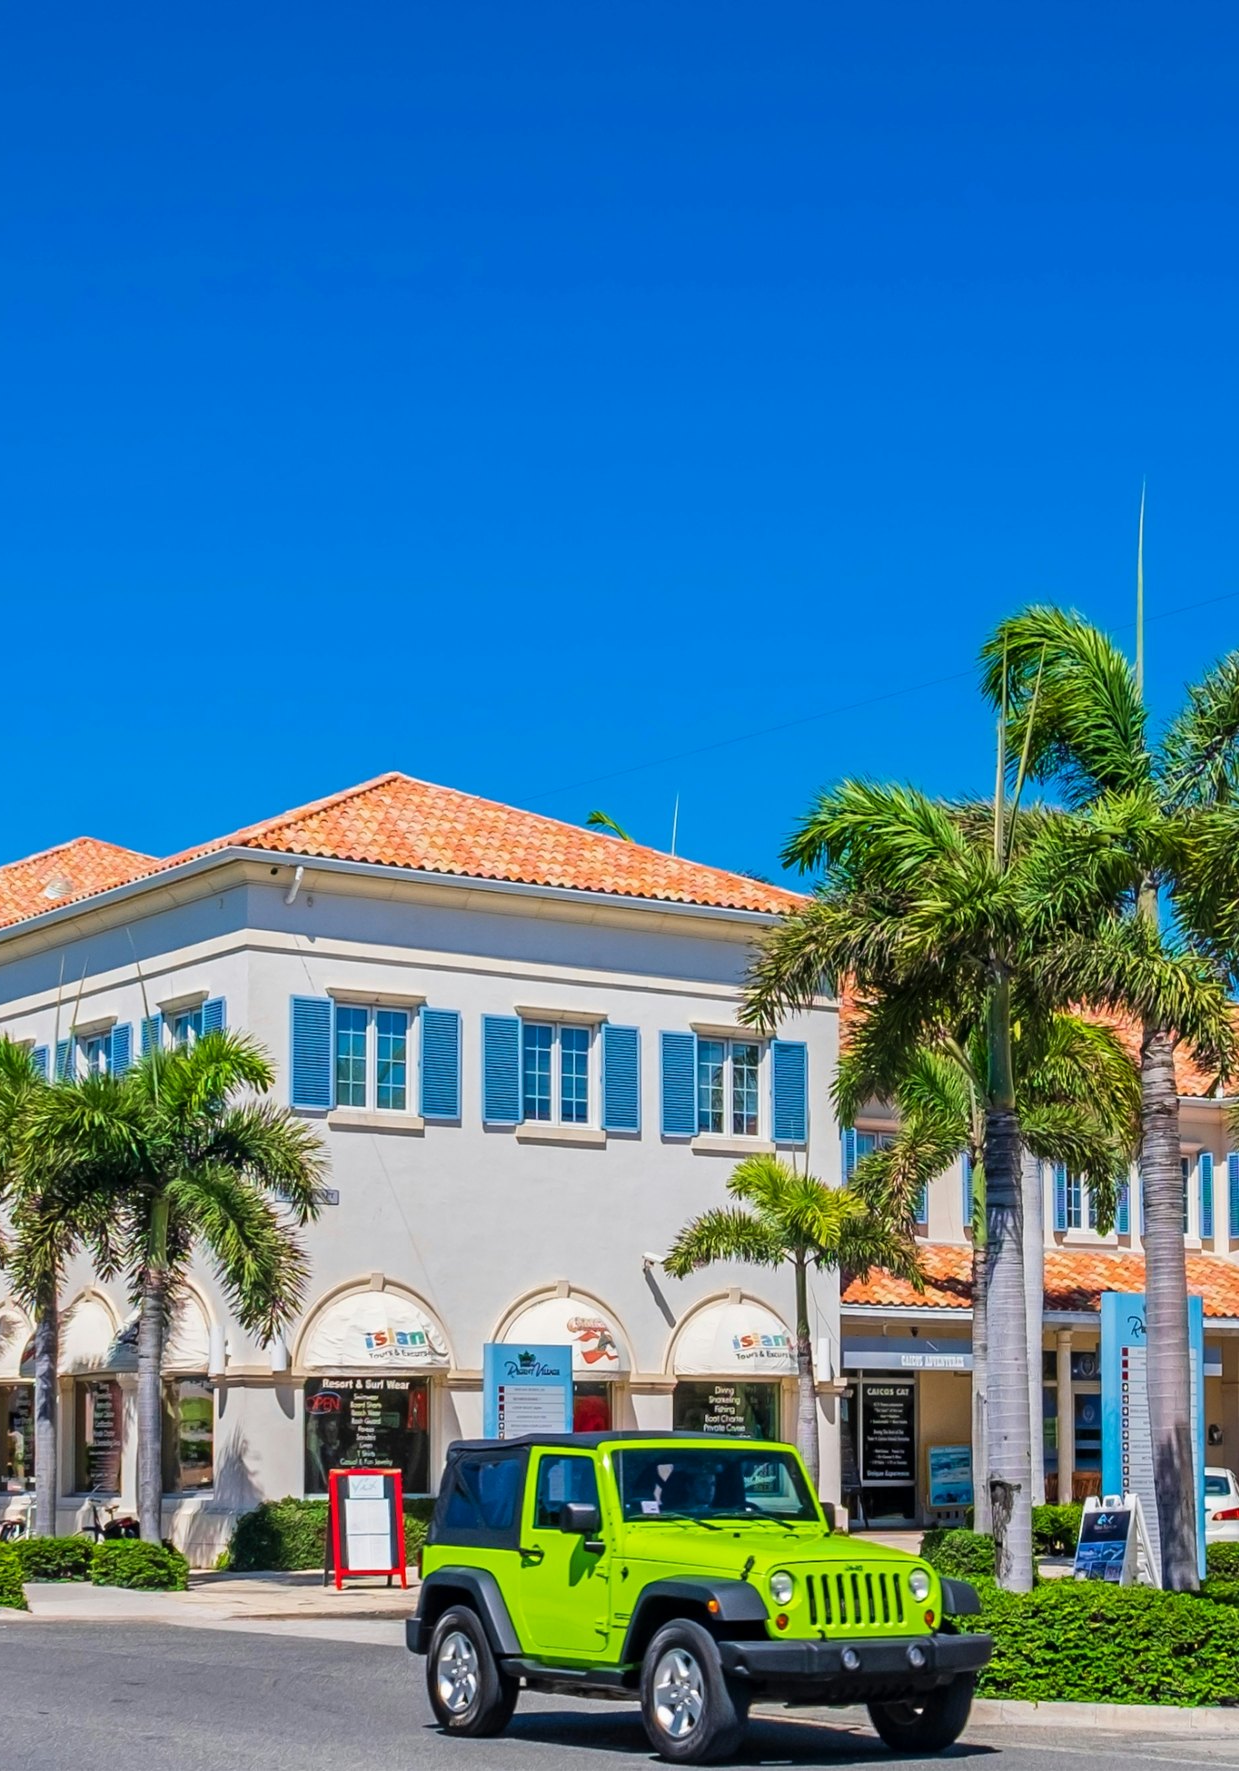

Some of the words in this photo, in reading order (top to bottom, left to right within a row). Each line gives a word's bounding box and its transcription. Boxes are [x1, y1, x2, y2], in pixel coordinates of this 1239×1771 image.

[322, 1378, 353, 1389] Resort
[355, 1379, 363, 1389] &
[365, 1379, 384, 1390] Surf
[386, 1379, 410, 1390] Wear
[867, 1388, 894, 1396] CAICOS
[896, 1388, 910, 1396] CAT
[705, 1414, 720, 1423] Boat
